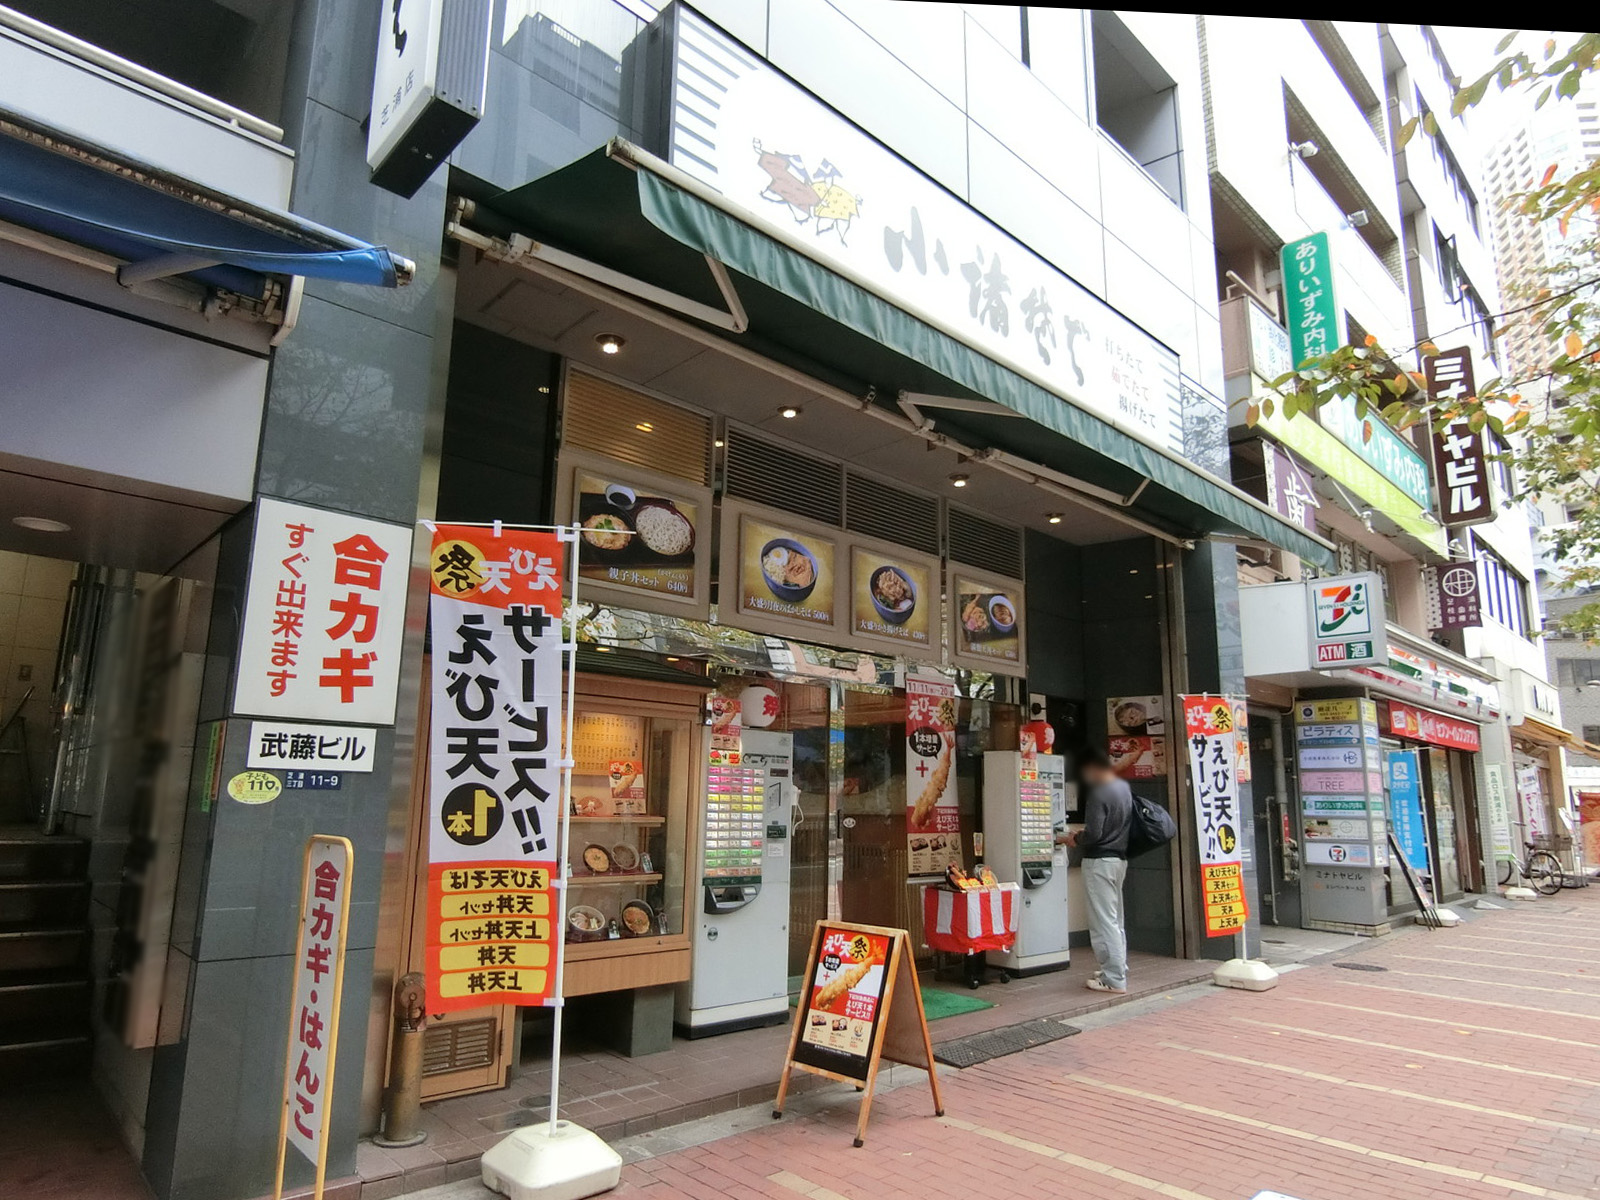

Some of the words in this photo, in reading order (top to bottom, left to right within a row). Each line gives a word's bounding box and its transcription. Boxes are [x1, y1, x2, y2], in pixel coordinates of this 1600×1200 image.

[1295, 241, 1327, 359] ありいずみ内科
[608, 566, 660, 587] 親子丼セット
[266, 523, 315, 697] すぐ出来ます
[319, 534, 389, 703] 合カギ
[1320, 644, 1344, 660] ATM
[1350, 643, 1367, 658] 酒
[1303, 725, 1354, 737] ピラティス
[260, 732, 366, 761] 武藤ビル
[311, 775, 339, 786] 11-9
[1317, 780, 1345, 791] TREE
[1316, 870, 1364, 881] ミナトヤビル
[294, 860, 341, 1140] 合カギ・はんこ
